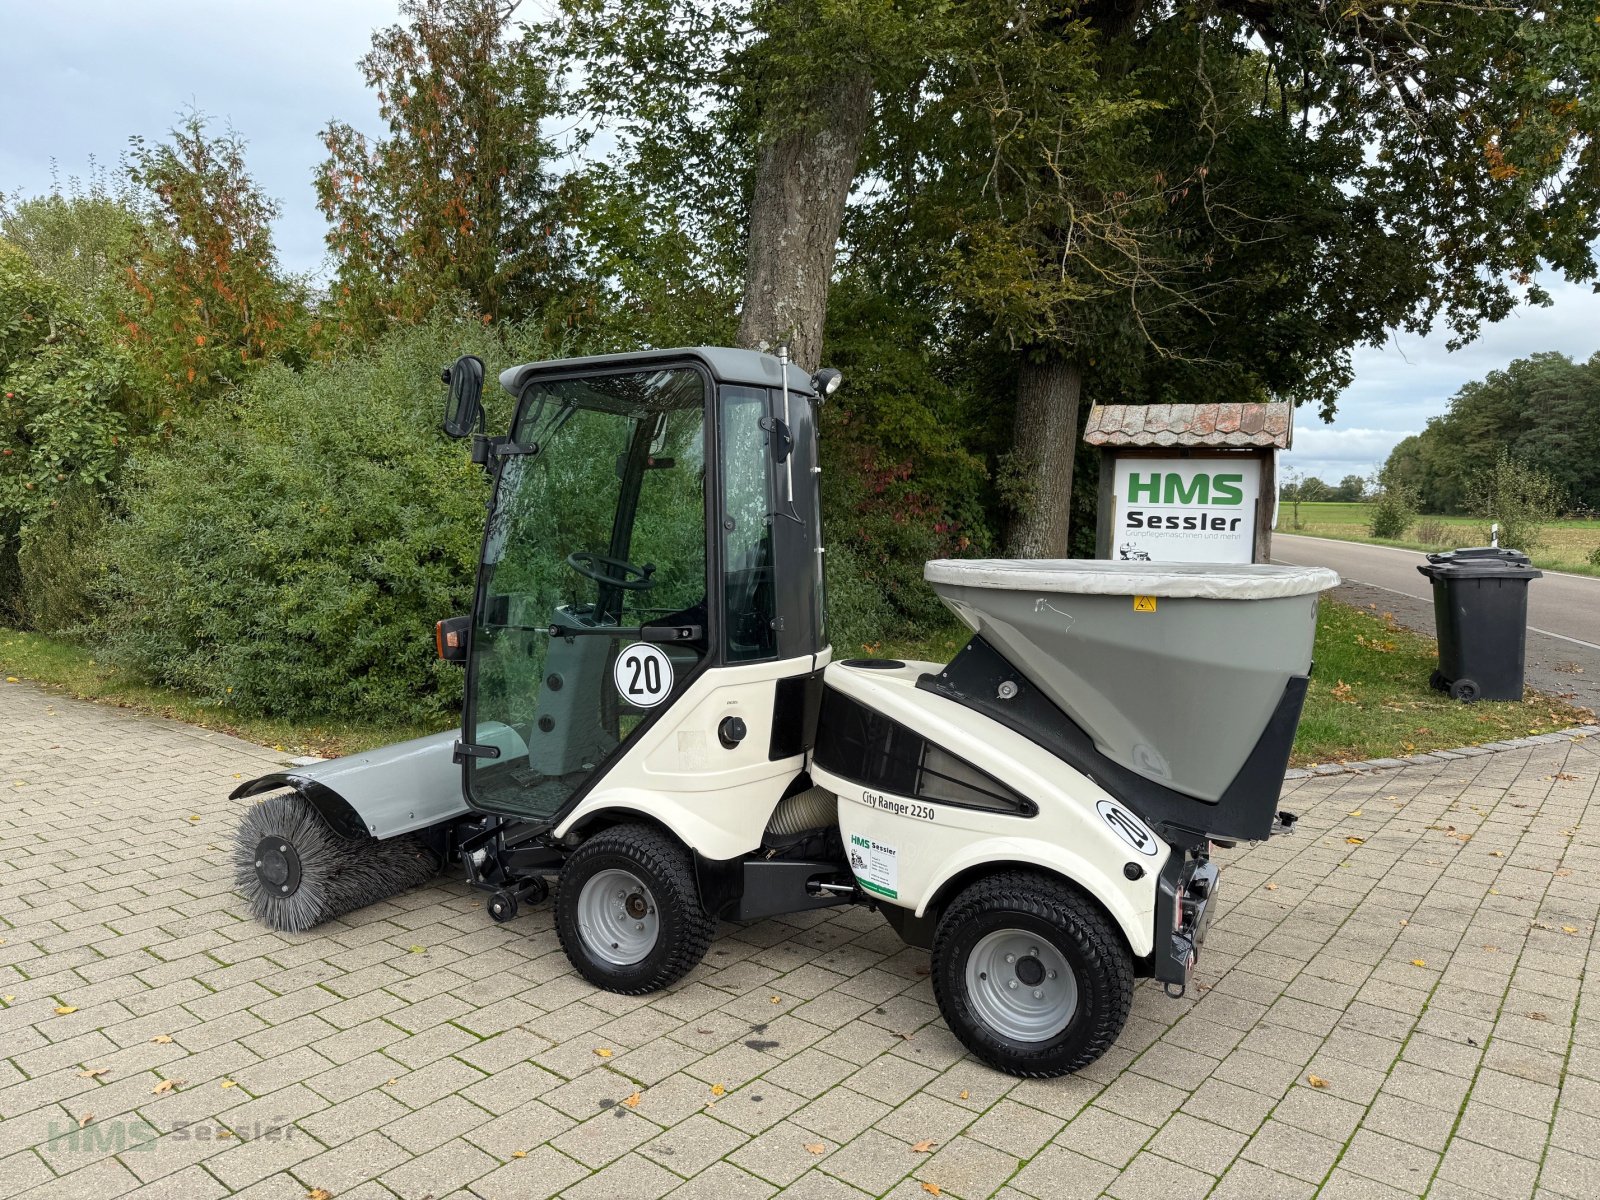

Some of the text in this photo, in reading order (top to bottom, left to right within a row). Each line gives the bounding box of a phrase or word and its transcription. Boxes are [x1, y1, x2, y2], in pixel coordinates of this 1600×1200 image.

[1128, 473, 1243, 505] HMS
[1126, 511, 1241, 531] Sessler
[1204, 531, 1218, 540] und
[625, 655, 662, 695] 20
[862, 790, 935, 820] City Ranger 2250
[1106, 807, 1148, 849] 20
[851, 834, 870, 849] HMS
[871, 842, 896, 856] Sessler
